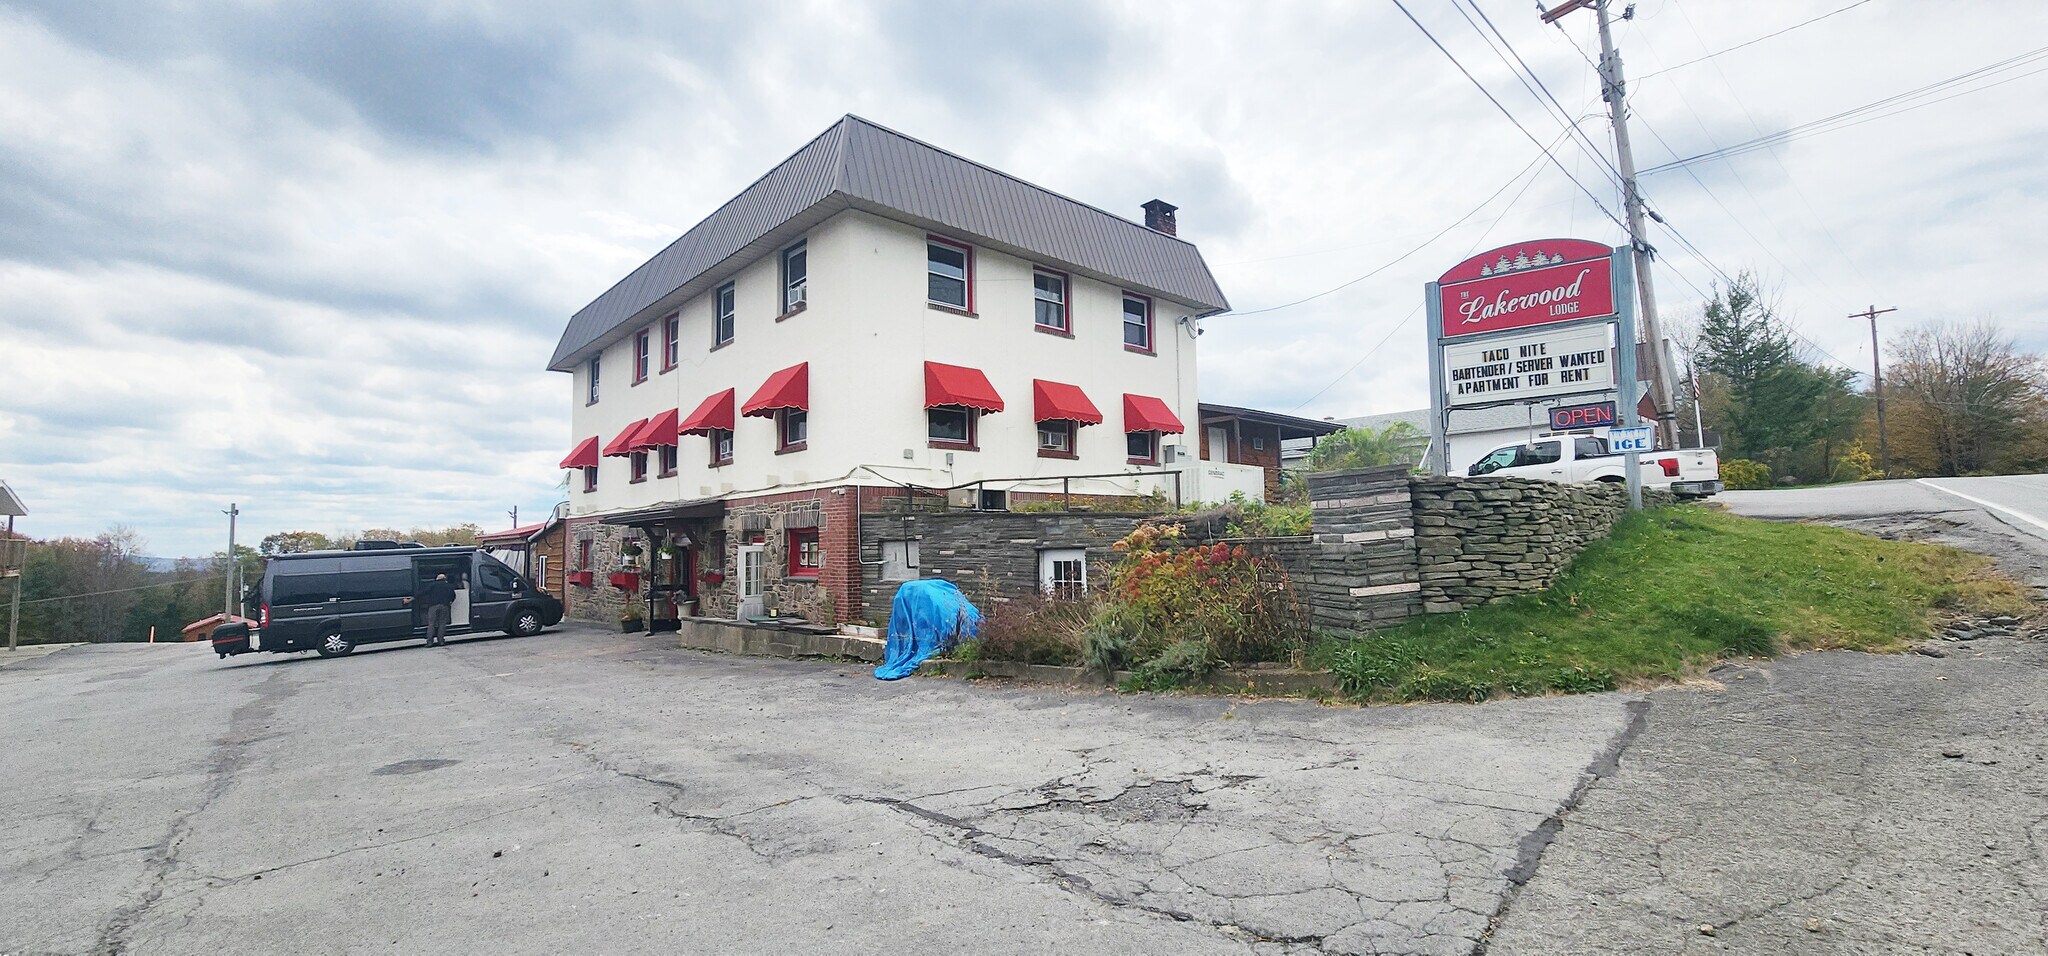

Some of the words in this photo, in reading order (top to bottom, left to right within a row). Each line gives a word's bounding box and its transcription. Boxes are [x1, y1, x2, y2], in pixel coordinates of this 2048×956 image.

[1459, 268, 1591, 325] Lakewood
[1549, 301, 1580, 316] LODGE
[1481, 348, 1510, 363] TACO
[1519, 342, 1547, 358] NITE
[1559, 350, 1605, 368] WANTED
[1457, 376, 1521, 396] APARTMENT
[1528, 372, 1549, 388] FOR
[1560, 367, 1591, 384] RENT
[1554, 406, 1612, 427] OPEN
[1614, 437, 1647, 450] ICE
